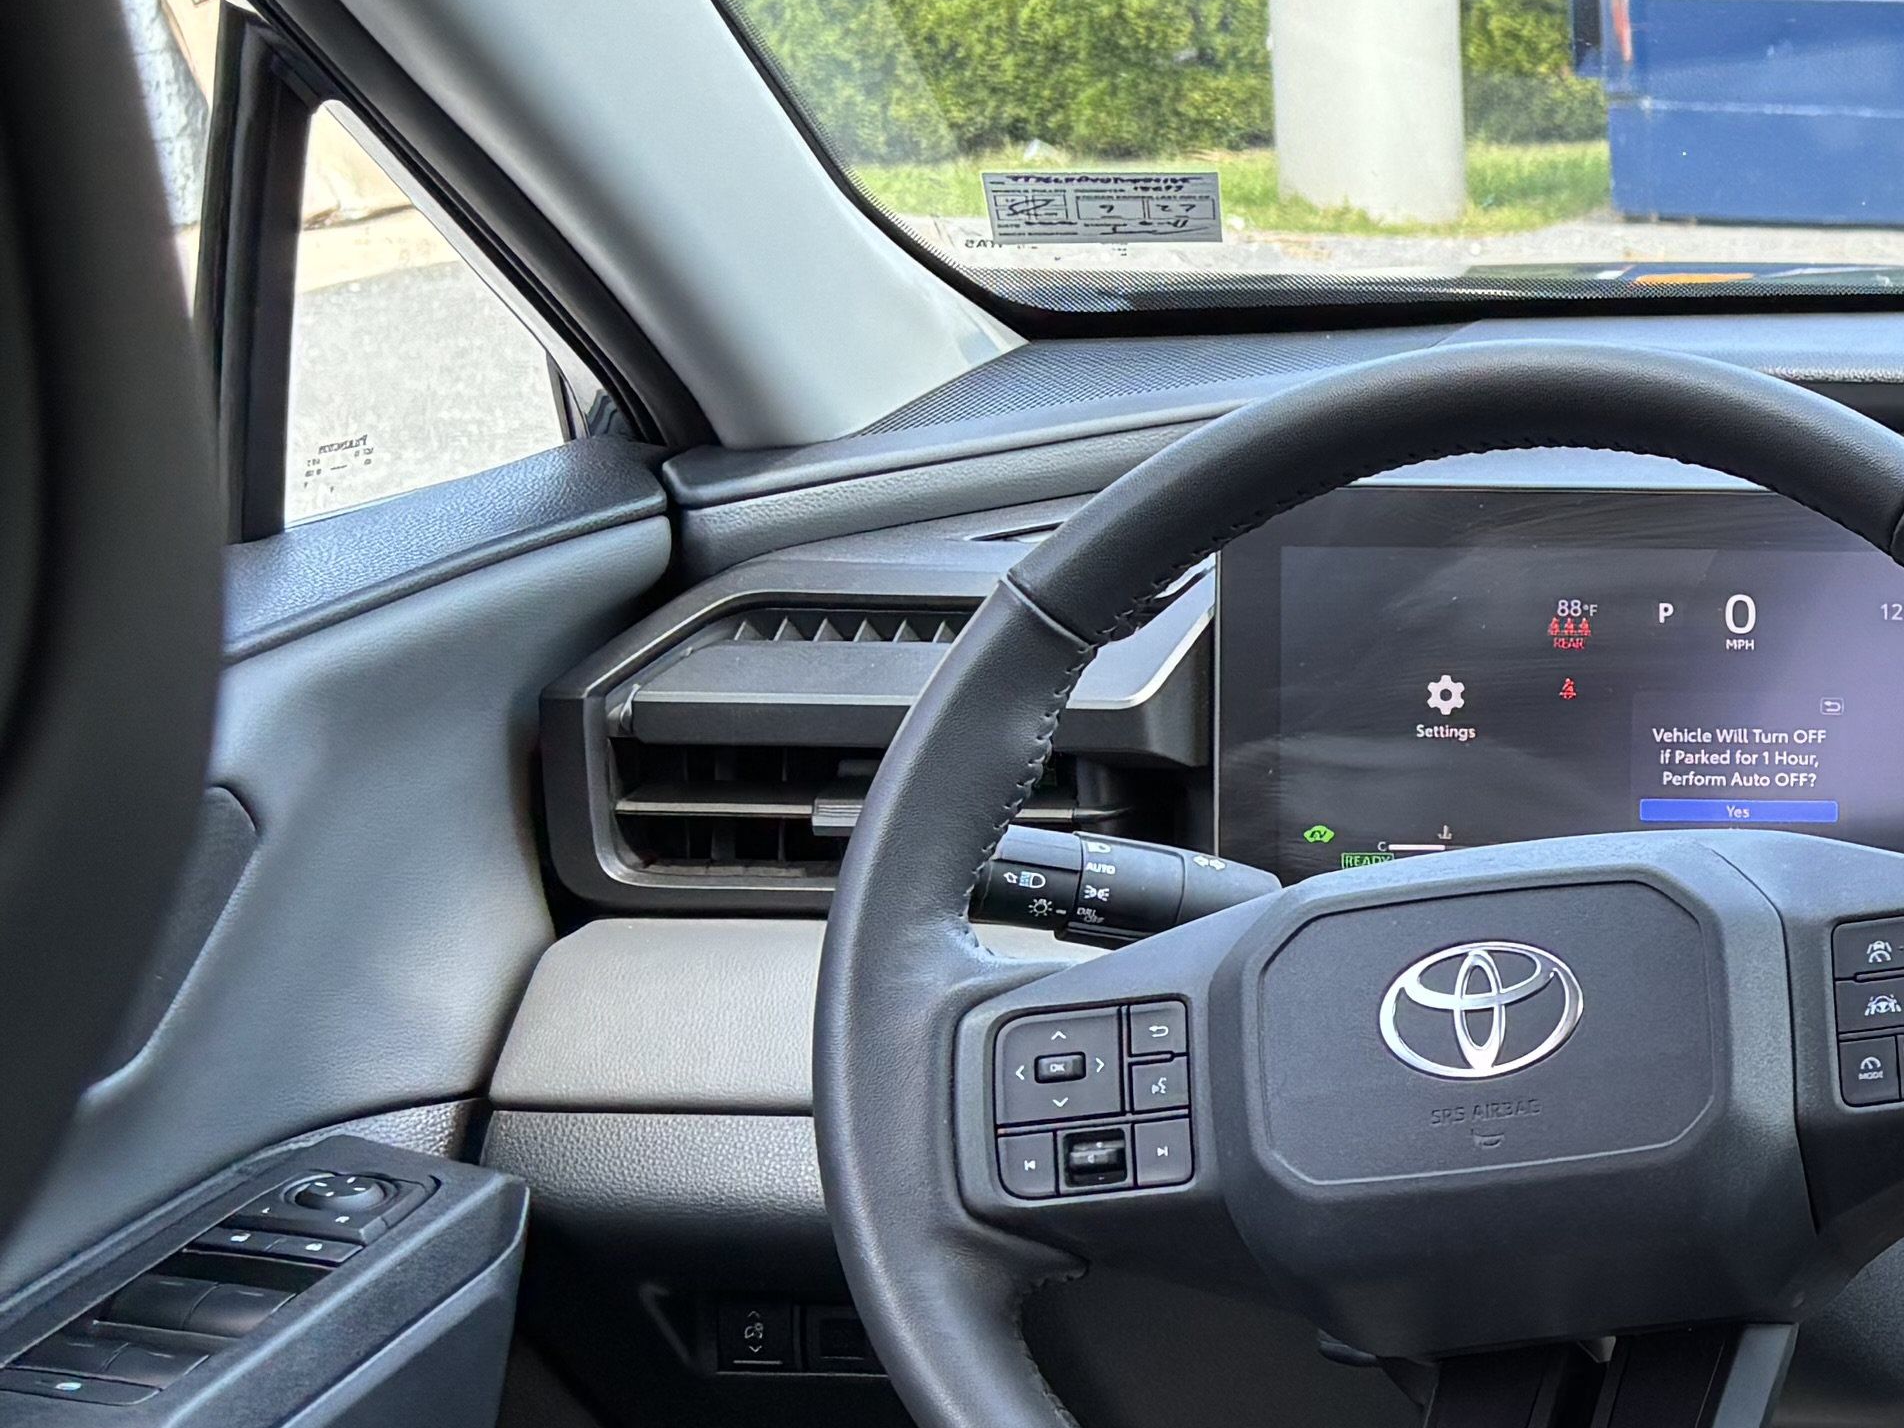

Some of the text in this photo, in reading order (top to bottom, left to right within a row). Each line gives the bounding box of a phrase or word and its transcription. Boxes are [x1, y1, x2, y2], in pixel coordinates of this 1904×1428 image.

[1657, 602, 1675, 624] P
[1724, 593, 1758, 635] 0
[1552, 637, 1586, 651] REAR
[1725, 638, 1755, 651] MPH
[1415, 723, 1477, 742] Settings
[1651, 728, 1827, 745] Vehicle Will Turn OFF
[1659, 749, 1820, 769] if Parked for 1 Hour,
[1662, 770, 1817, 788] Perform Auto OFF?
[1726, 804, 1751, 819] Yes
[1377, 841, 1387, 853] C
[1085, 861, 1116, 875] AUTO
[1344, 853, 1393, 868] READY
[1048, 1062, 1067, 1073] OK
[1858, 1070, 1884, 1080] MODE
[1431, 1098, 1541, 1125] SRS AIRBAG
